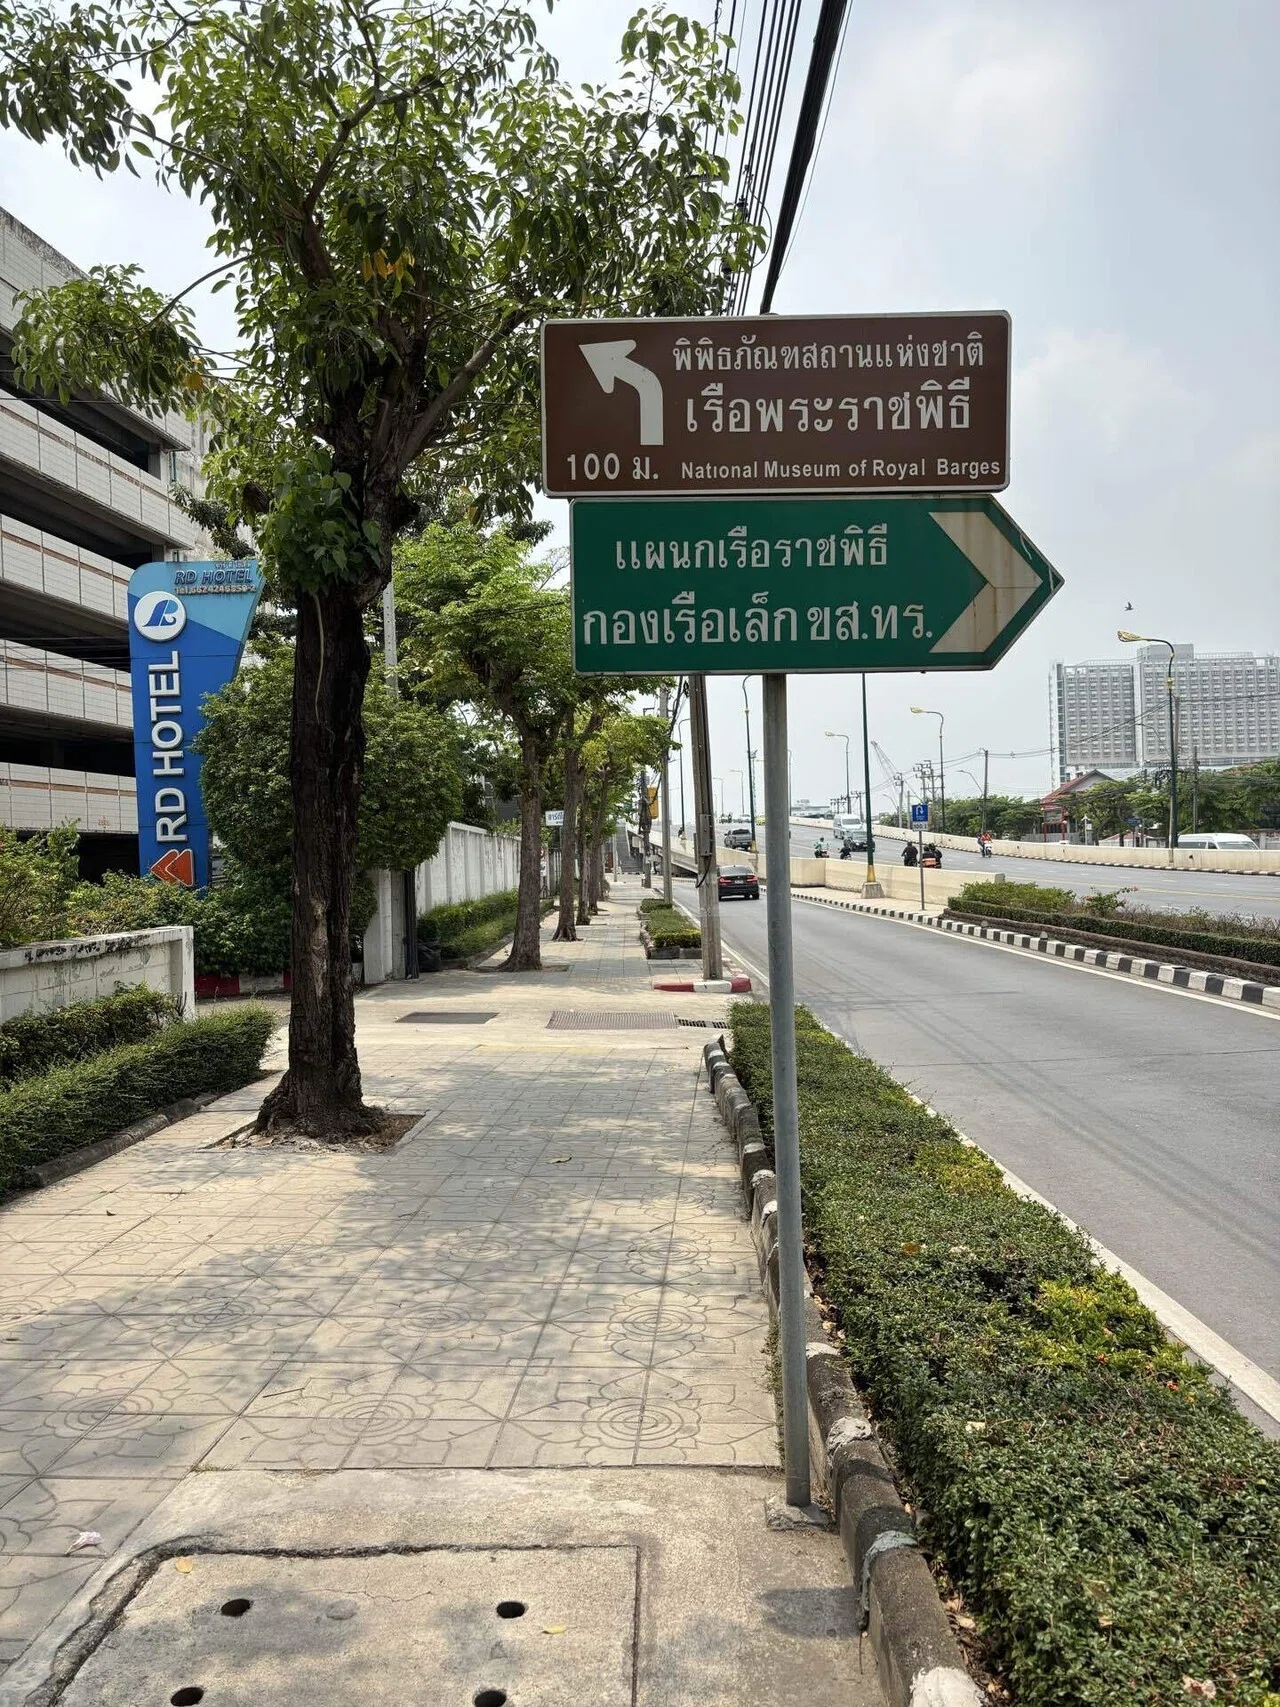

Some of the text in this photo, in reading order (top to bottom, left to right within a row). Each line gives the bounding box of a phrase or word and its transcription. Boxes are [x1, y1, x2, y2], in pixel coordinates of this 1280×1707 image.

[672, 331, 984, 371] พิพิธภัณฑสถานแห่งชาติ
[686, 376, 971, 433] เรือพระราชพิธี
[567, 453, 659, 480] 100 ม.
[681, 457, 1000, 481] National Museum of Royal Barges
[615, 523, 888, 570] แผนกเรือราชพิธี
[175, 569, 253, 585] RD HOTEL
[582, 590, 798, 645] กองเรือเล็ก
[148, 650, 188, 843] RD HOTEL
